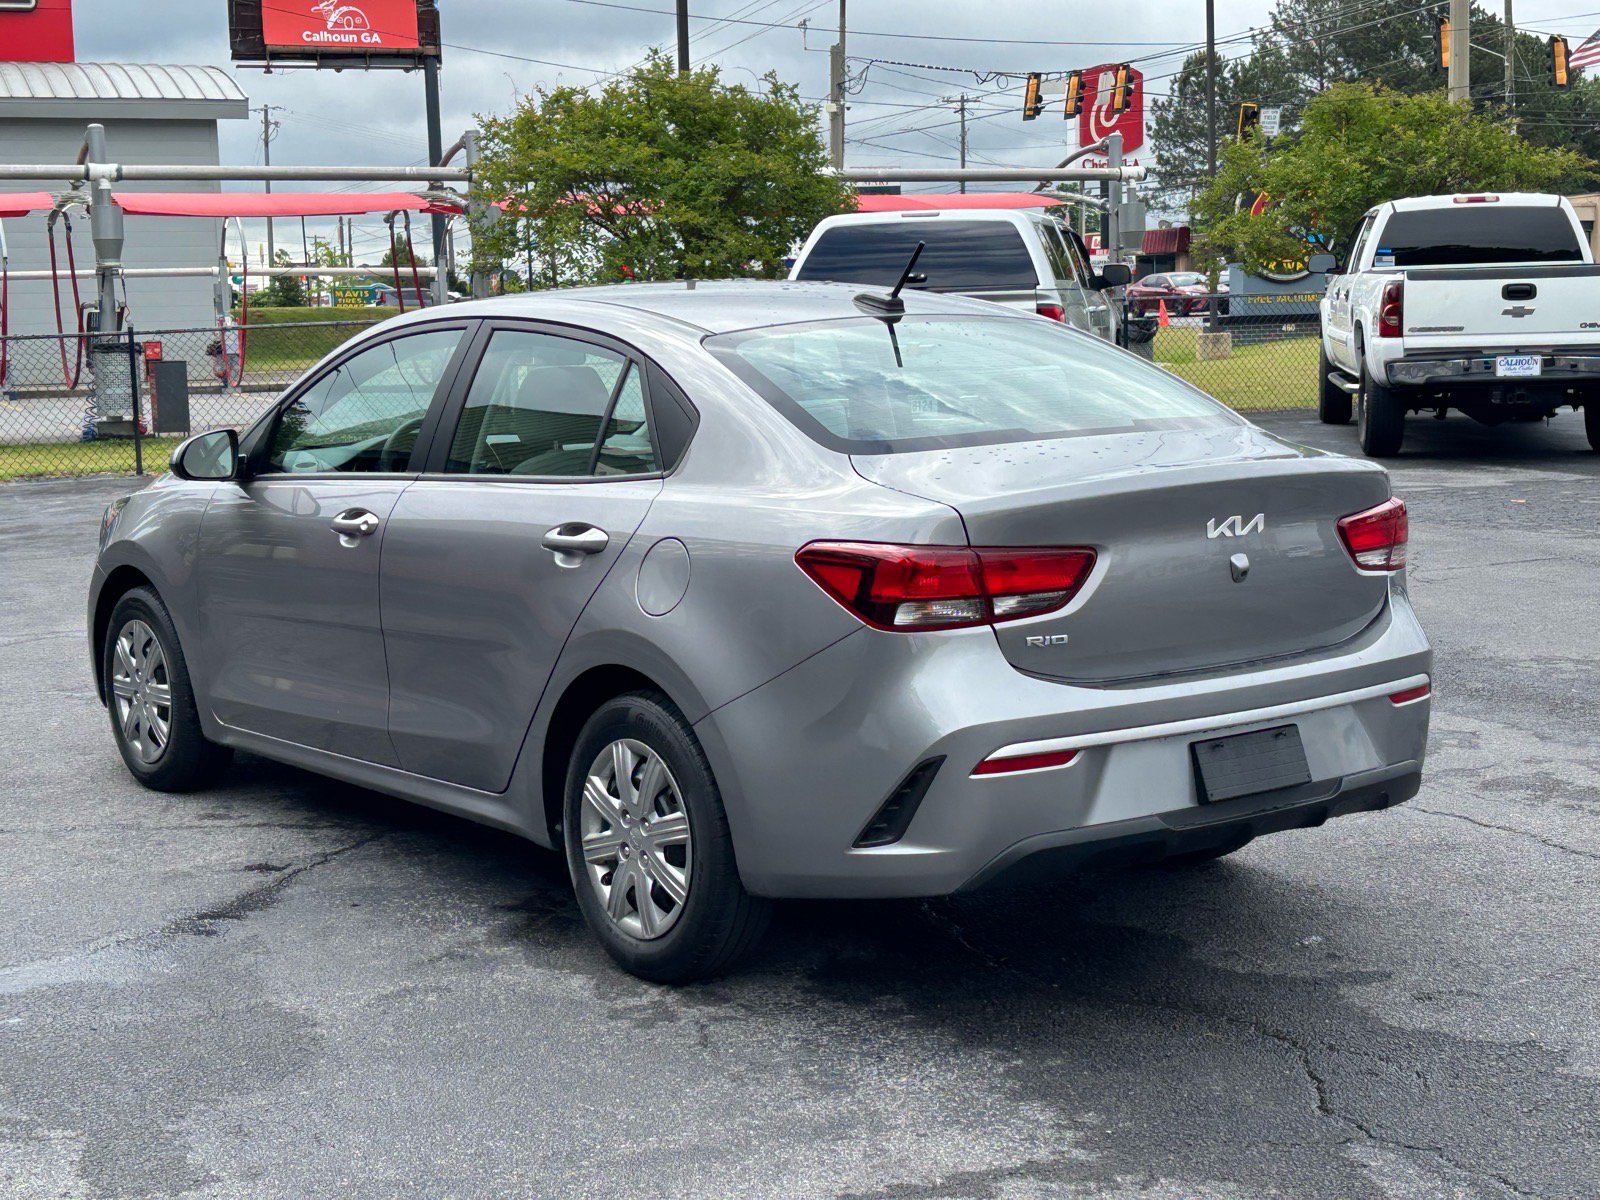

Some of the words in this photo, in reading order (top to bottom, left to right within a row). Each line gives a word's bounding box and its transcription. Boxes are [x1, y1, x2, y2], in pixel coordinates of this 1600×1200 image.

[302, 31, 357, 43] Calhoun
[360, 34, 382, 43] GA
[335, 290, 370, 298] MAVIS
[1247, 296, 1273, 304] FREE
[1499, 359, 1539, 367] CALHOUN
[1206, 513, 1265, 539] KIA
[1025, 634, 1069, 647] RIO
